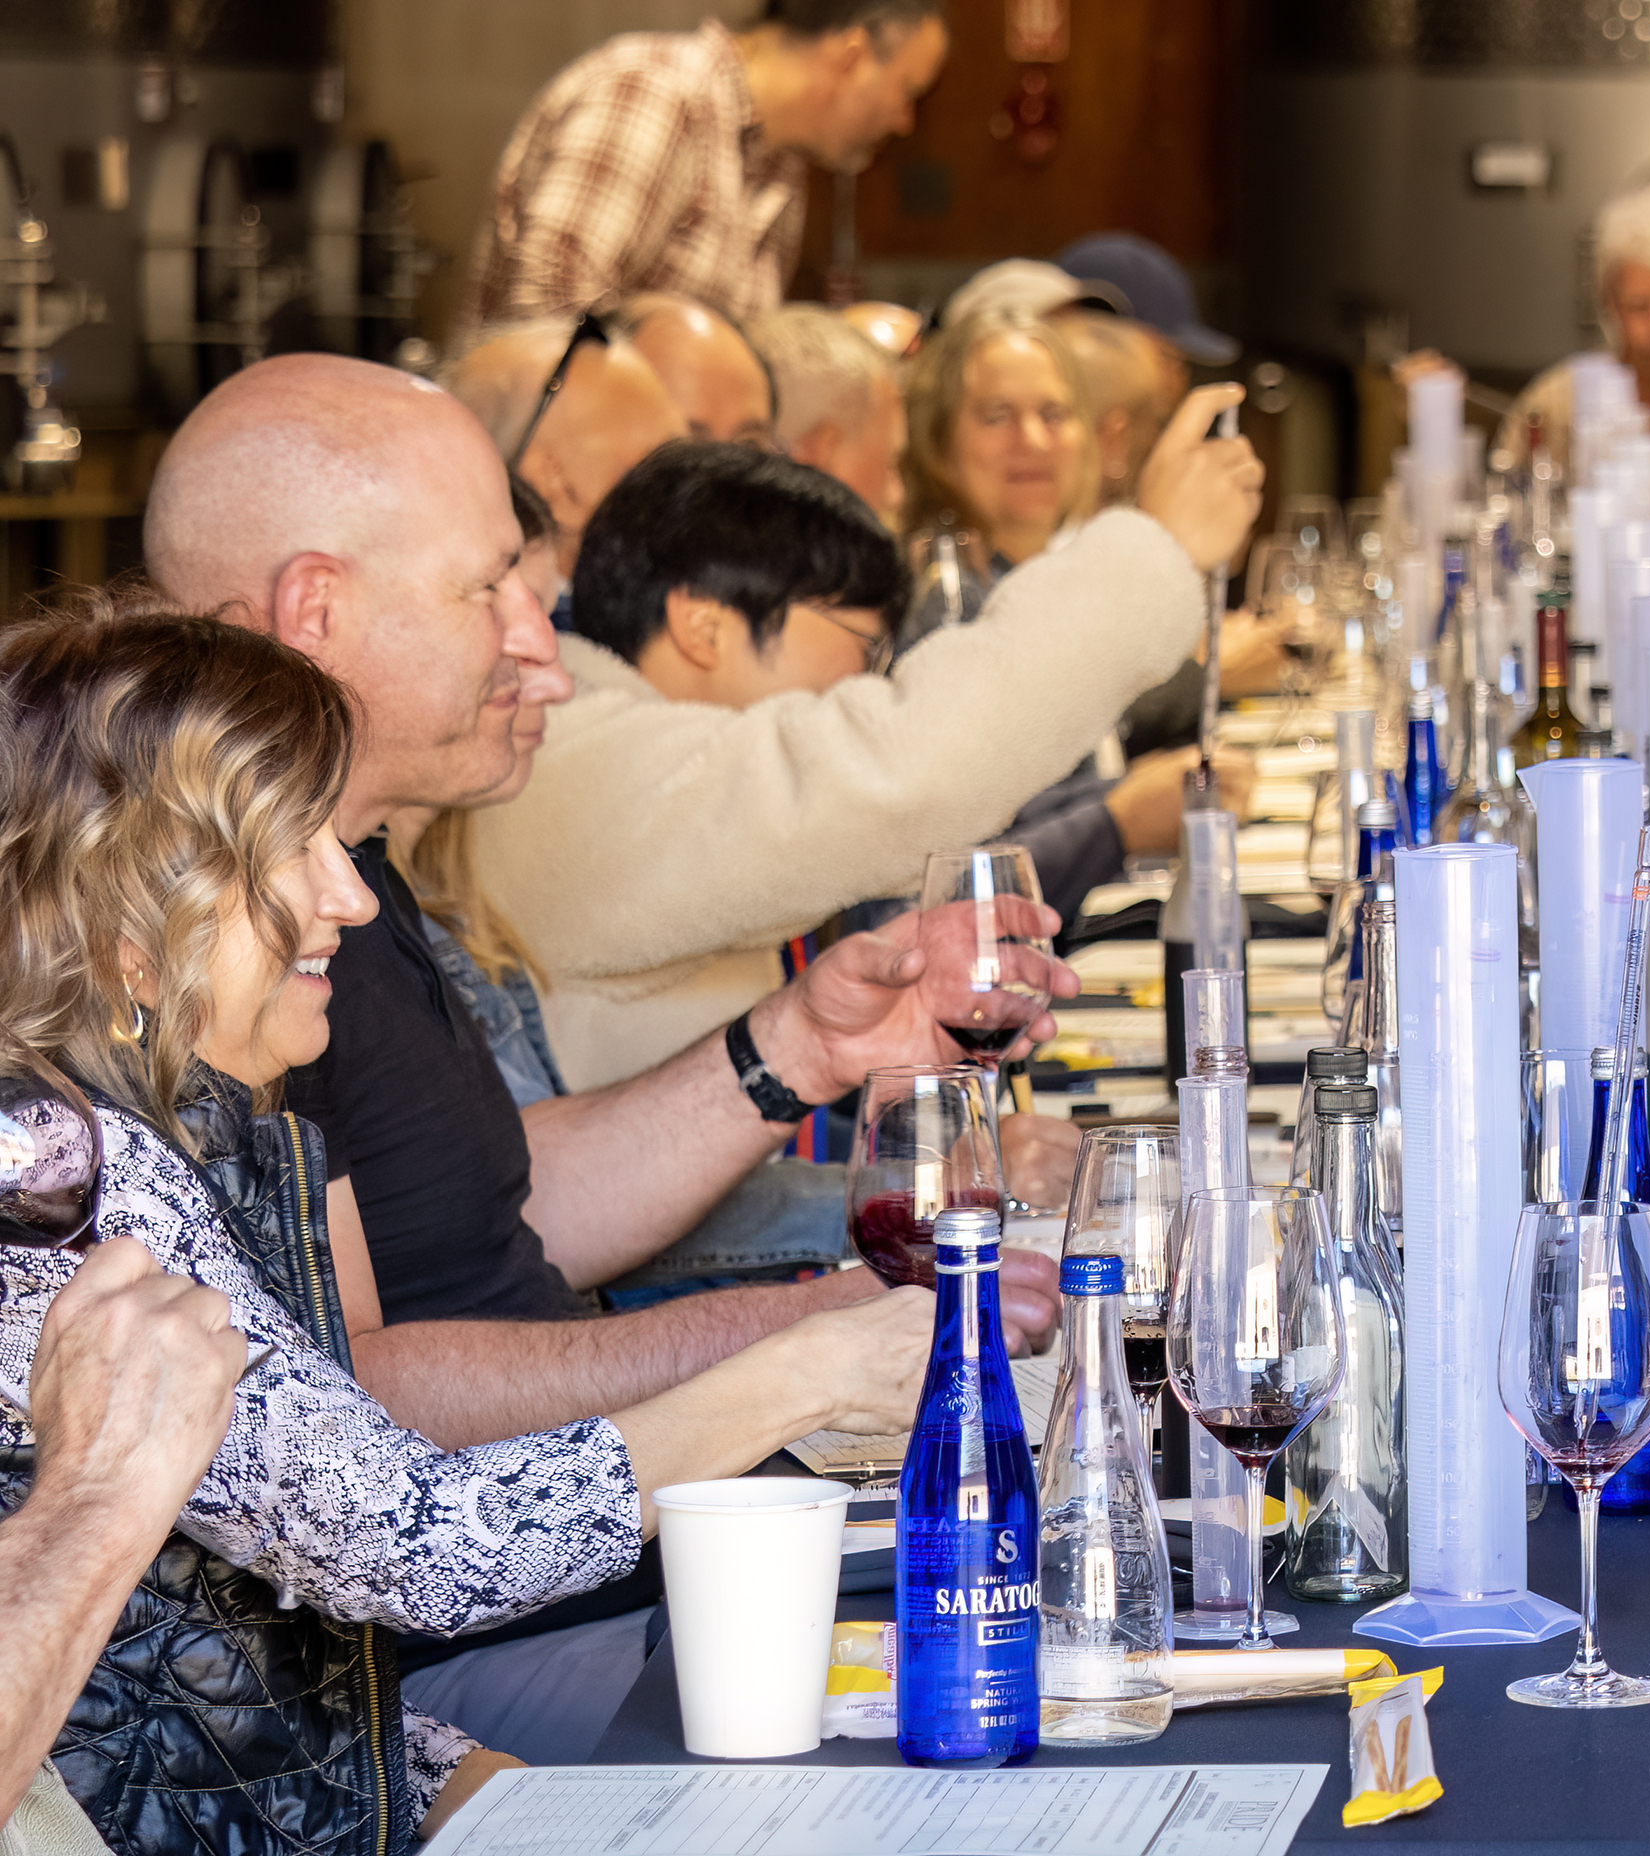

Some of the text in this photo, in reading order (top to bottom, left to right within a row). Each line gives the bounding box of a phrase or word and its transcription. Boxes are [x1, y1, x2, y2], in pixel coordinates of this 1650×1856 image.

[977, 1574, 1009, 1586] SINCE
[988, 1625, 1027, 1639] STILL
[975, 1668, 1008, 1680] Perfectly
[970, 1698, 1009, 1710] SPRING
[979, 1716, 989, 1729] 12
[989, 1716, 998, 1728] FL
[1223, 1800, 1279, 1833] PRIDE
